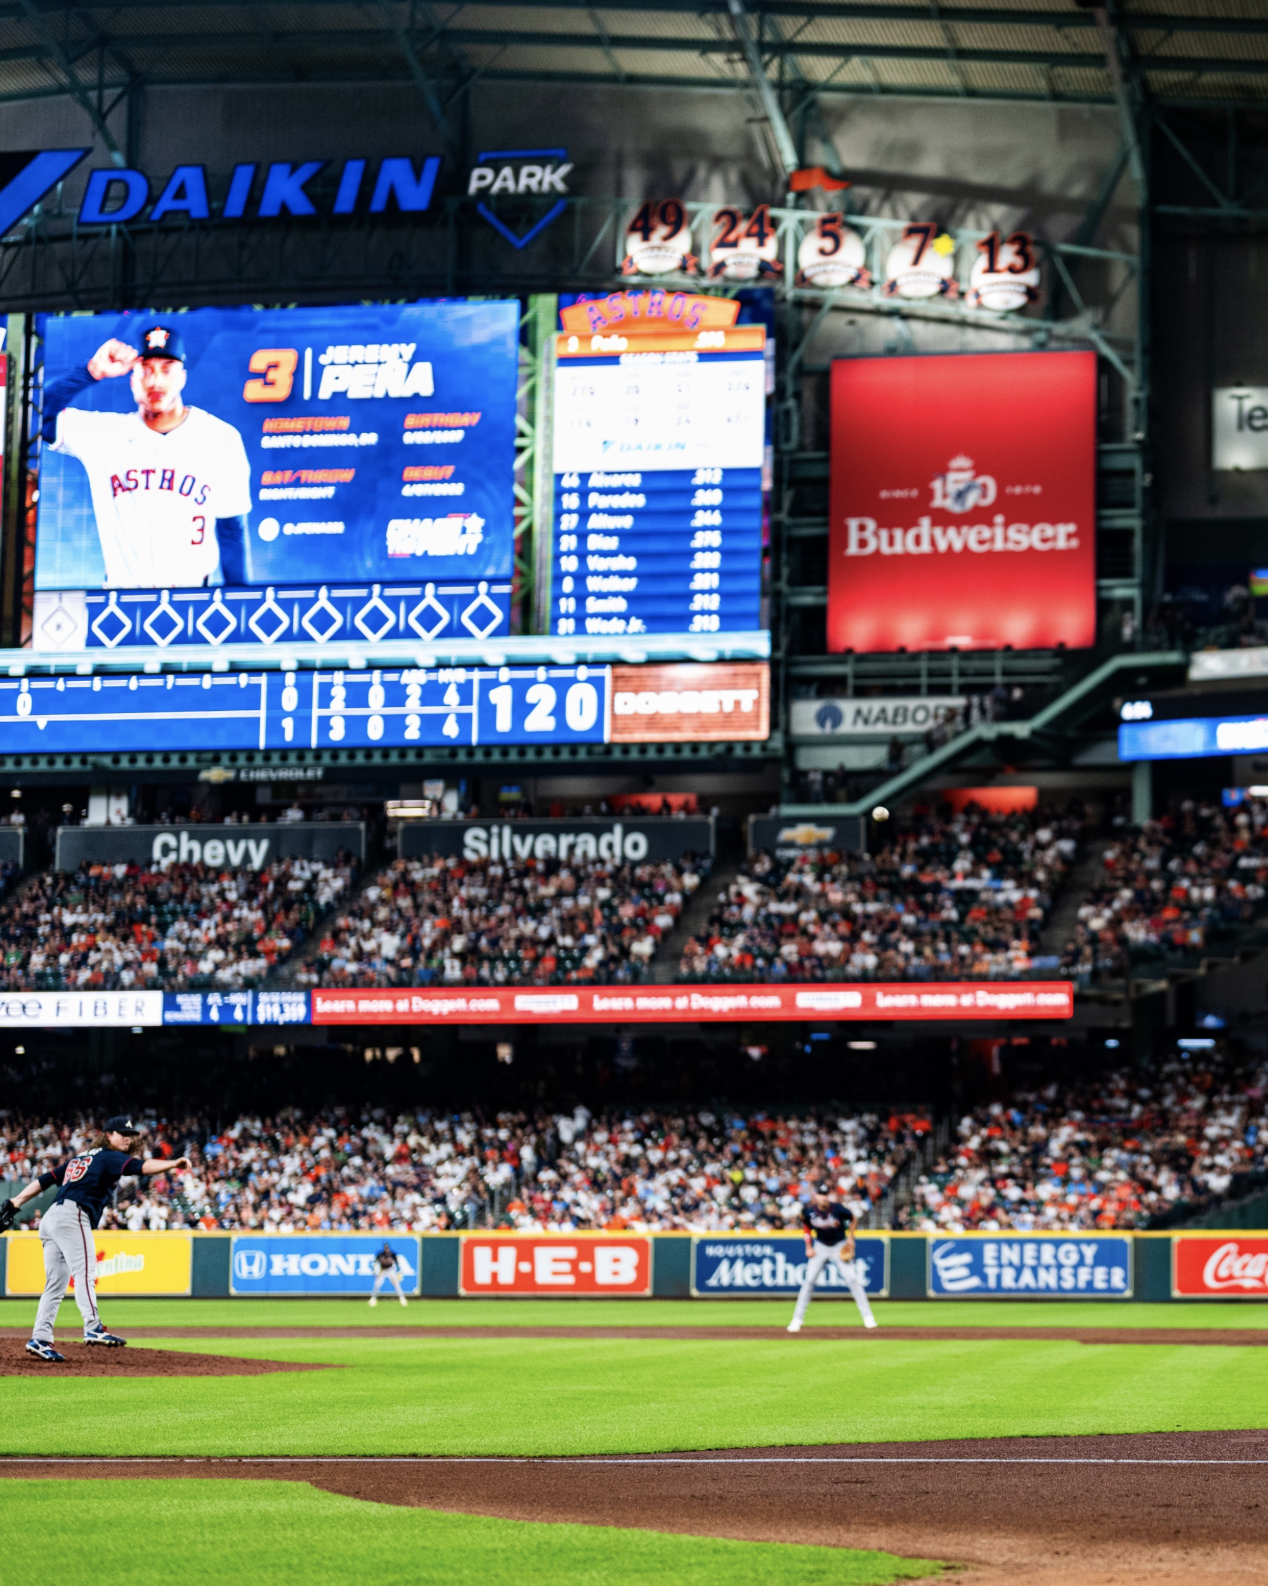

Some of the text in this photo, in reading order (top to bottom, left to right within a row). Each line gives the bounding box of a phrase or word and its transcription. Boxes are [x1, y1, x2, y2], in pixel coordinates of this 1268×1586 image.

[77, 155, 442, 226] DAIKIN
[469, 162, 573, 195] PARK
[627, 200, 688, 243] 49
[711, 204, 776, 250] 24
[818, 212, 844, 257] 5
[903, 222, 938, 267] 7
[976, 231, 1036, 275] 13
[586, 289, 708, 332] ASTROS
[318, 343, 416, 365] JEREMY
[243, 349, 298, 402] 3
[318, 361, 434, 400] PEÑA
[110, 467, 211, 505] ASTROS
[191, 515, 205, 545] 3
[16, 682, 460, 717] 0 0 2 0 2 4
[281, 712, 459, 742] 1 3 0 2 4
[240, 767, 324, 781] CHEVROLET
[152, 830, 269, 872] Chevy
[463, 823, 648, 861] Silverado
[56, 998, 146, 1018] FIBER
[316, 996, 356, 1013] Learn
[358, 998, 393, 1013] more
[412, 996, 500, 1016] Doggett.com
[593, 994, 634, 1011] Learn
[636, 996, 672, 1011] more
[876, 991, 918, 1008] Learn
[473, 1246, 638, 1285] H-E-B
[705, 1244, 774, 1258] HOUSTON
[983, 1242, 1099, 1266] ENERGY
[986, 1266, 1127, 1290] TRANSFER
